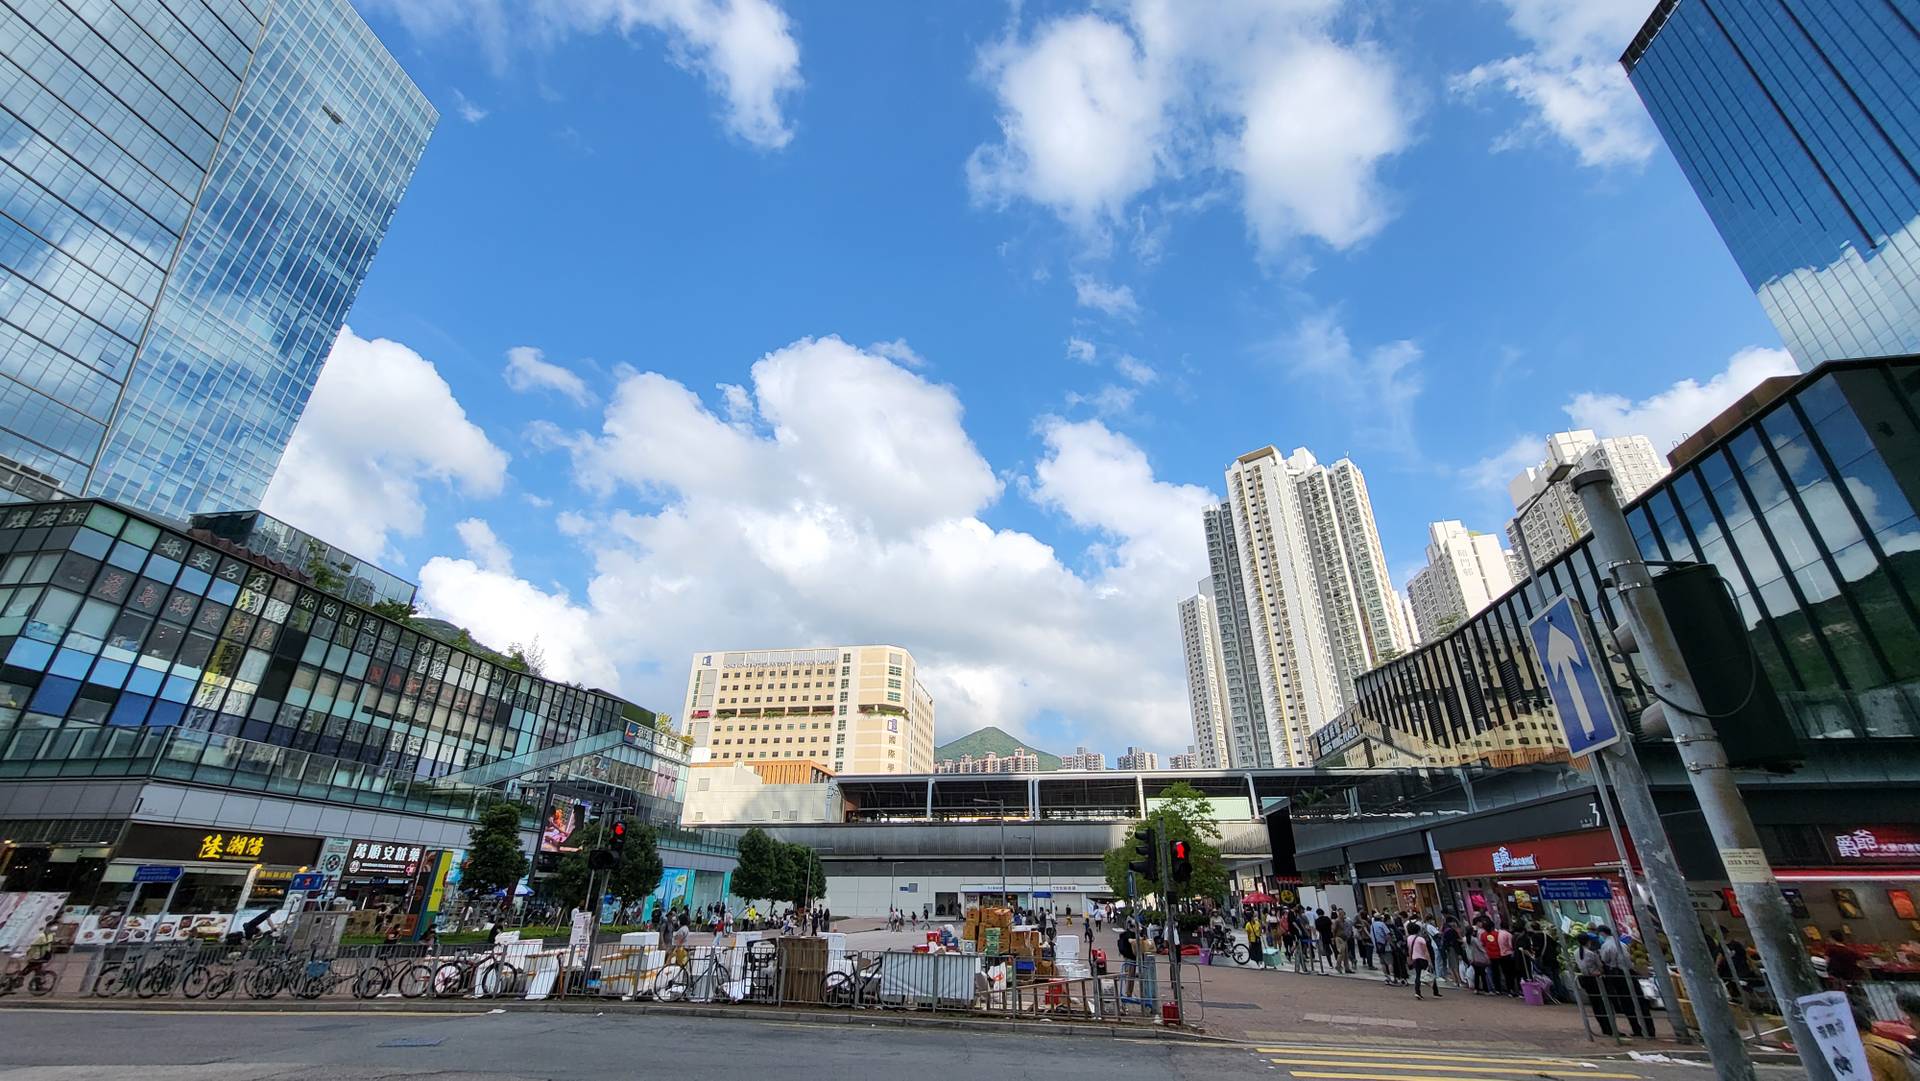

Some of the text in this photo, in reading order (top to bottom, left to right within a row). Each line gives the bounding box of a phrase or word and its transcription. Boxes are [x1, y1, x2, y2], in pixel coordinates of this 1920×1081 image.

[160, 538, 267, 592] 婚宴名店
[299, 593, 376, 634] 你的首選
[1588, 802, 1601, 827] 3
